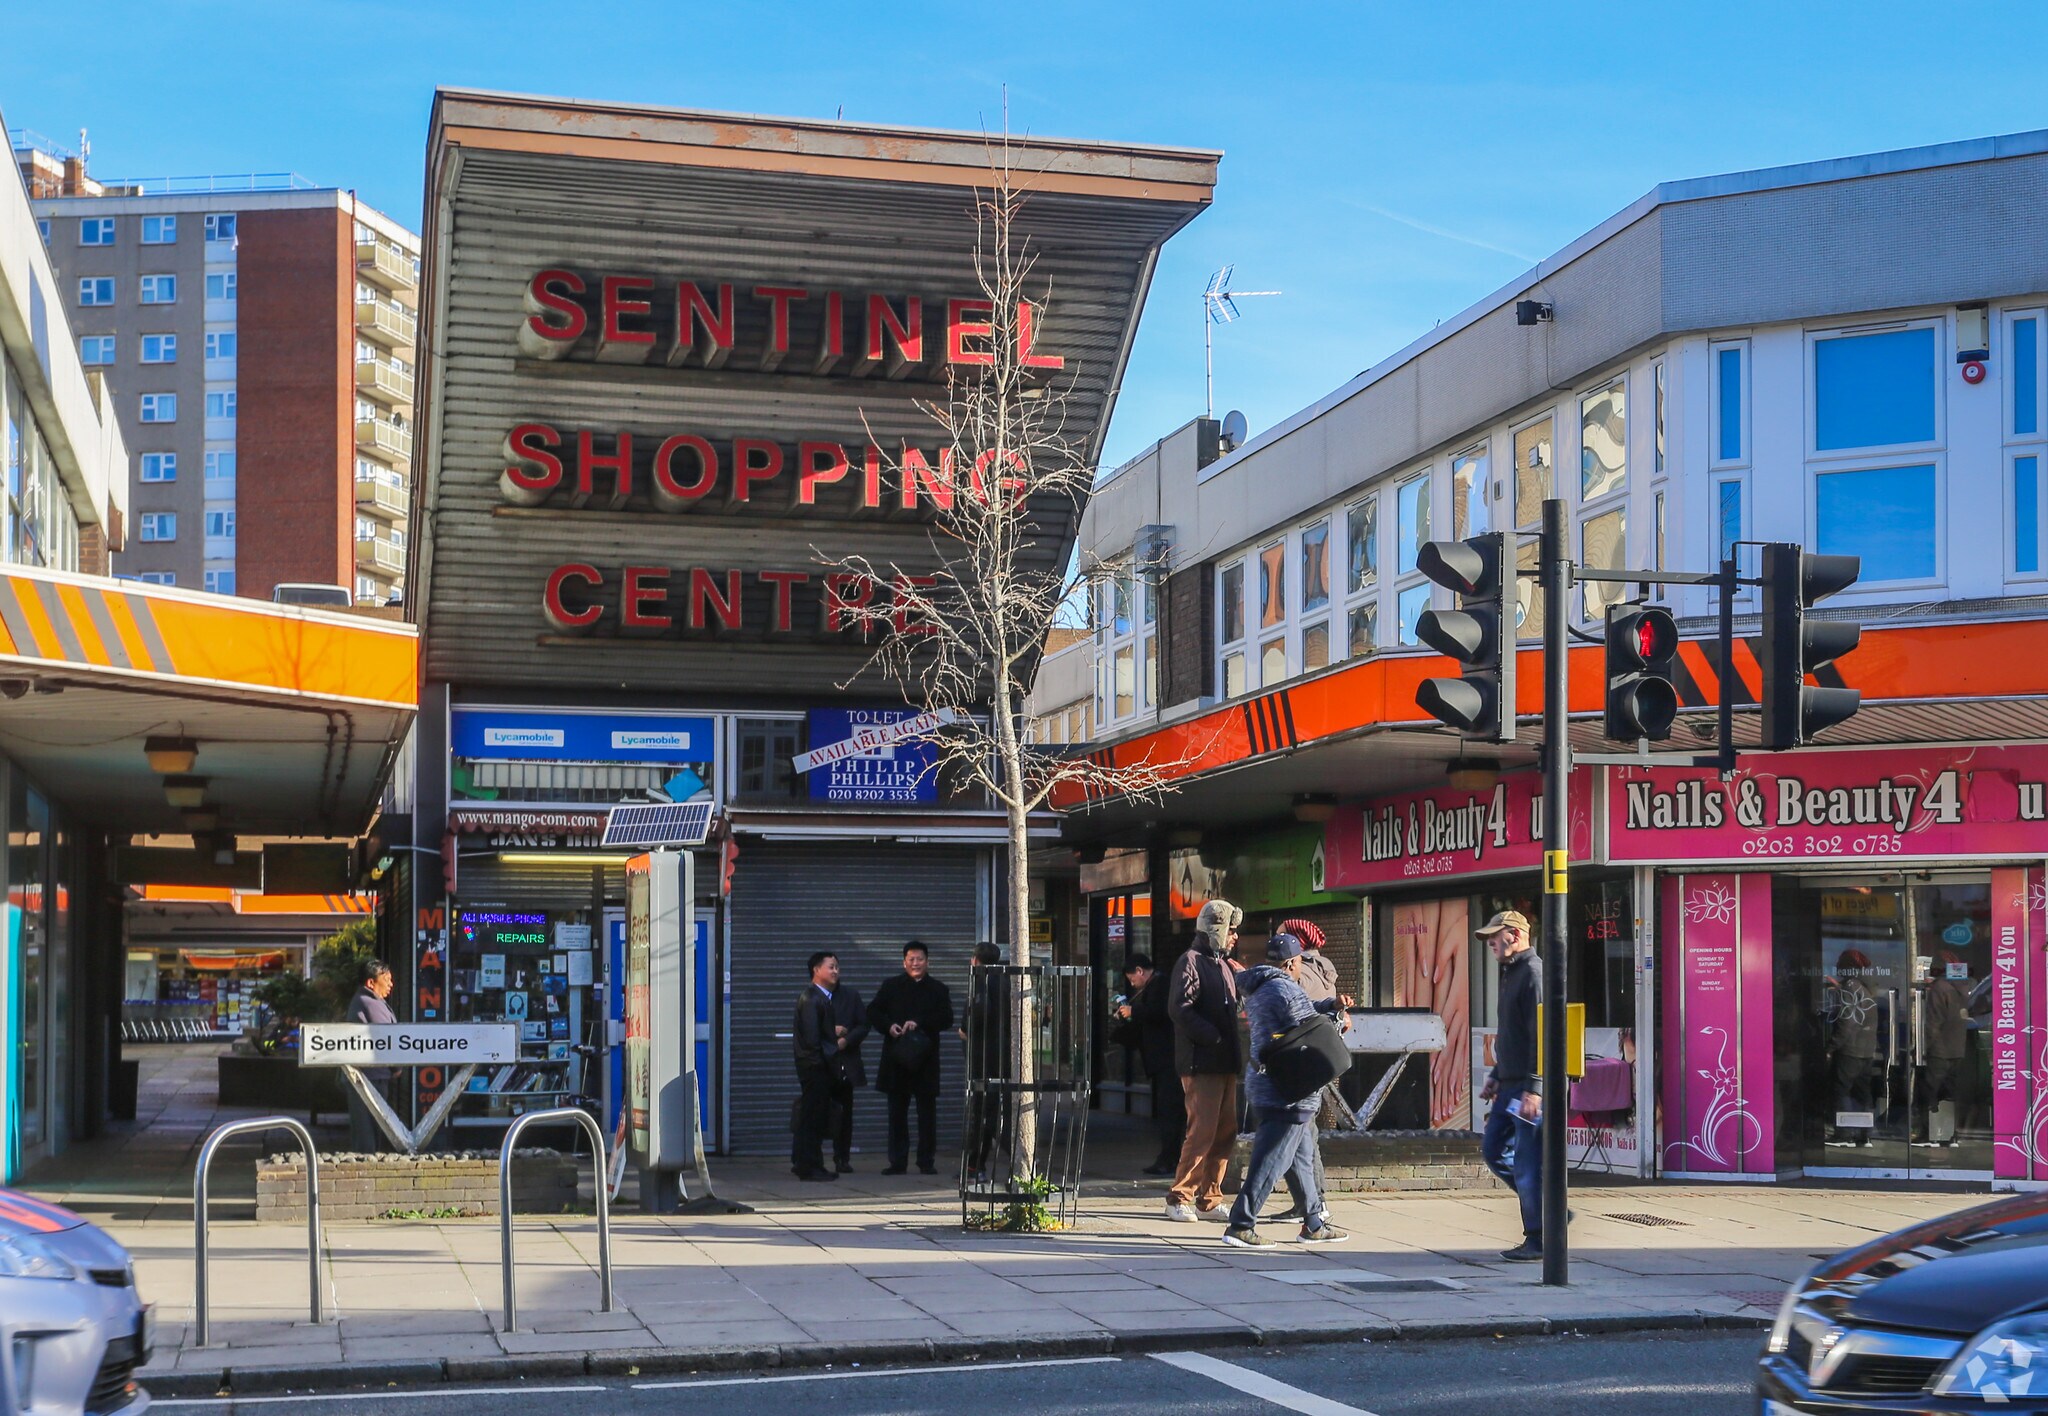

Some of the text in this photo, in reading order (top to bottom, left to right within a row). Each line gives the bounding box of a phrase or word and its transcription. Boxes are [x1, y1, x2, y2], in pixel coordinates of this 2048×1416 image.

[528, 268, 1065, 369] SENTINEL
[505, 423, 1028, 510] SHOPPING
[544, 563, 938, 635] CENTRE
[847, 710, 904, 725] TO LET
[494, 732, 554, 742] Lycamobile
[621, 736, 680, 745] Lycamobile
[809, 712, 942, 768] AVAILABLE AGAIN
[831, 760, 915, 773] PHILIP
[831, 773, 916, 786] PHILLIPS
[828, 789, 917, 801] 020 8202 3535
[1627, 781, 1723, 828] Nails
[1737, 779, 1763, 827] &
[1777, 779, 1917, 833] Beauty
[1921, 771, 1961, 823] 4
[1362, 805, 1402, 862] Nails
[1407, 801, 1419, 856] &
[1423, 796, 1486, 860] Beauty
[1487, 783, 1506, 847] 4
[1742, 834, 1902, 855] 0203 302 0735
[1404, 855, 1453, 876] 0203 302 0735
[462, 912, 546, 925] ALL MOBILE PHONE
[1584, 900, 1621, 921] NAILS
[496, 933, 545, 944] REPAIRS
[1587, 920, 1620, 939] & SPA
[1832, 966, 1859, 978] Beauty
[1862, 966, 1873, 976] for
[1876, 966, 1891, 976] You
[1996, 926, 2019, 1090] Nails & Beauty 4 You
[310, 1035, 468, 1053] Sentinel Square
